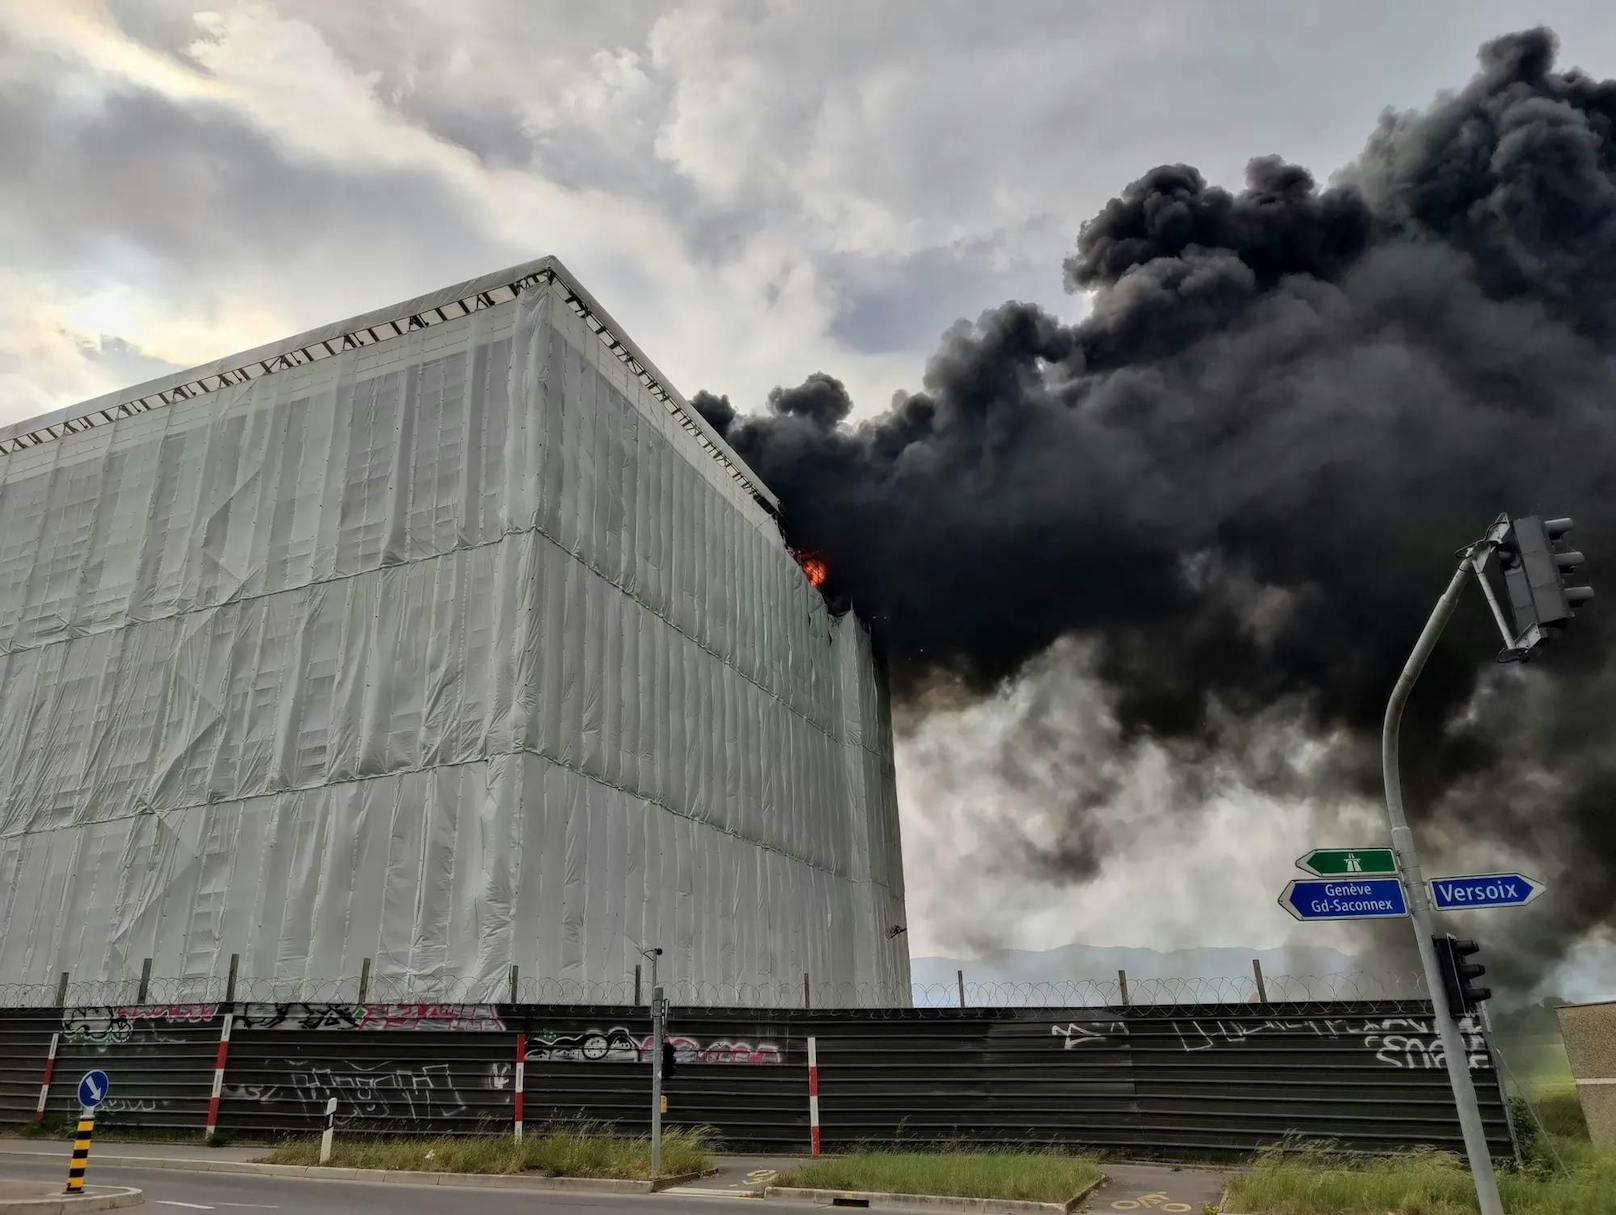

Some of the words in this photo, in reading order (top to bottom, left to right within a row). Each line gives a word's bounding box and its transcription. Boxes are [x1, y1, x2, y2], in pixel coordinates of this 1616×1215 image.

[1325, 883, 1371, 896] Genève
[1438, 880, 1518, 902] Versoix
[1311, 899, 1393, 912] Gd-Saconnex
